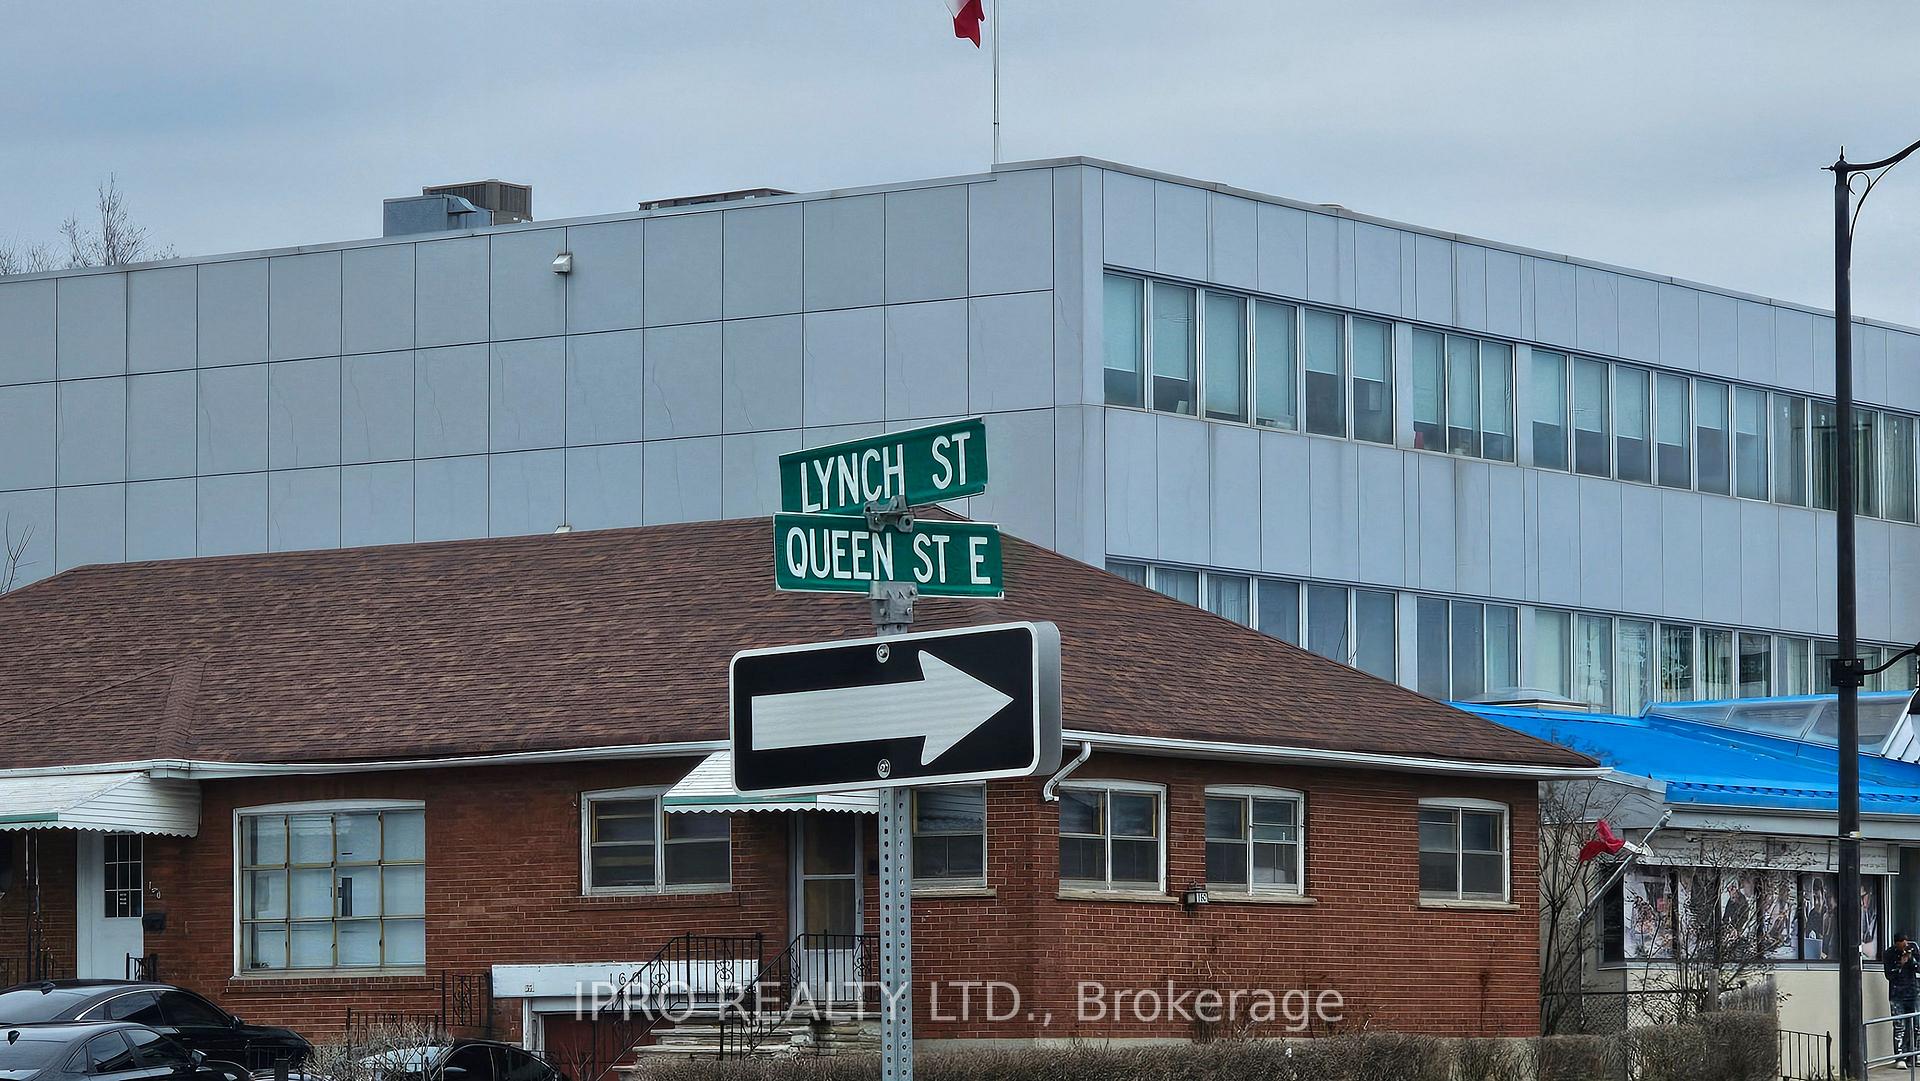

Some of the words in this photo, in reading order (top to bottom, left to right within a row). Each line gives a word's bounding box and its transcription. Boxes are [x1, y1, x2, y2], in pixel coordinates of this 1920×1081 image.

[801, 444, 905, 513] LYNCH
[931, 432, 971, 489] ST
[786, 527, 894, 580] QUEEN
[913, 534, 950, 583] ST
[969, 536, 991, 584] E
